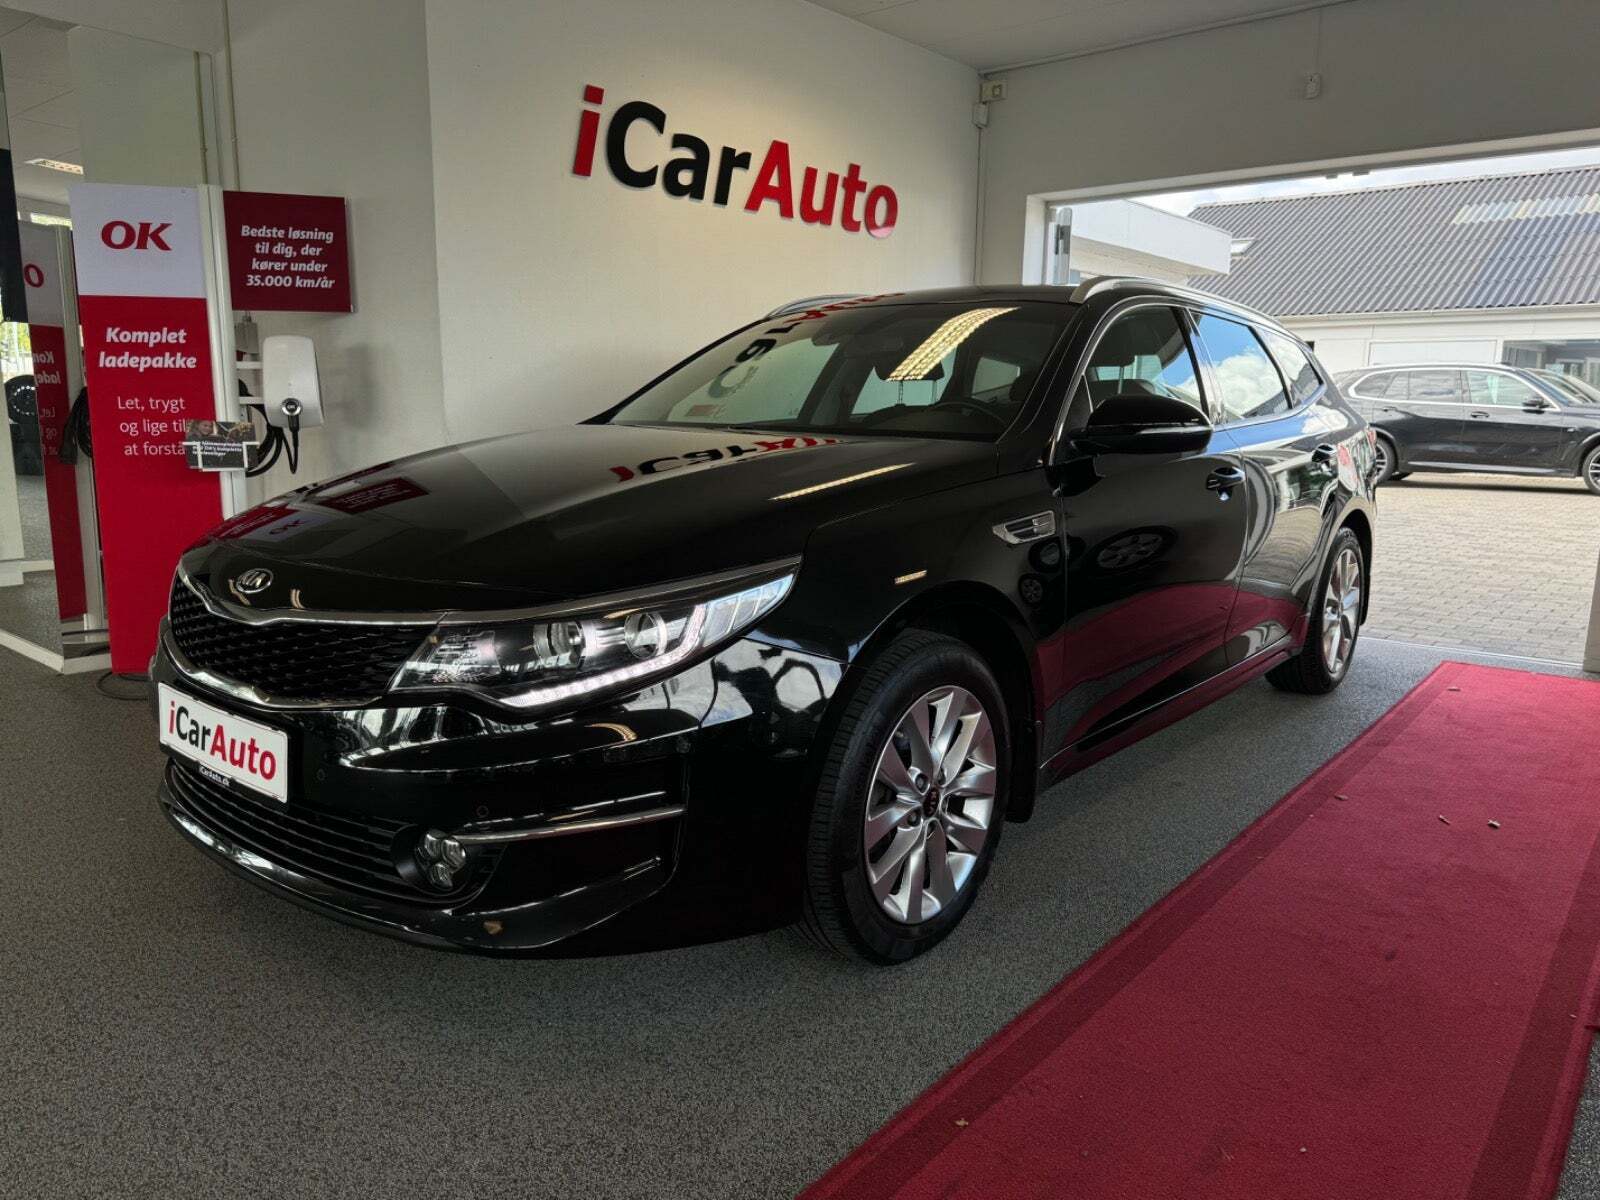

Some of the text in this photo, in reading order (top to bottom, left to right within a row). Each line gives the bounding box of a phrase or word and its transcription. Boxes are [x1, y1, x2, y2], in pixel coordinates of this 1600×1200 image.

[572, 84, 899, 239] iCarAuto
[100, 220, 173, 251] OK
[240, 224, 334, 244] Bedste løsning
[255, 241, 322, 260] til dig, der
[252, 257, 328, 273] kører under
[246, 274, 336, 290] 35.000 km/år
[106, 326, 187, 348] Komplet
[98, 351, 198, 373] ladepakke
[117, 396, 187, 414] Let, trygt
[119, 418, 186, 437] og lige til
[124, 443, 139, 456] at
[143, 441, 186, 456] forstå
[168, 701, 277, 781] iCarAuto
